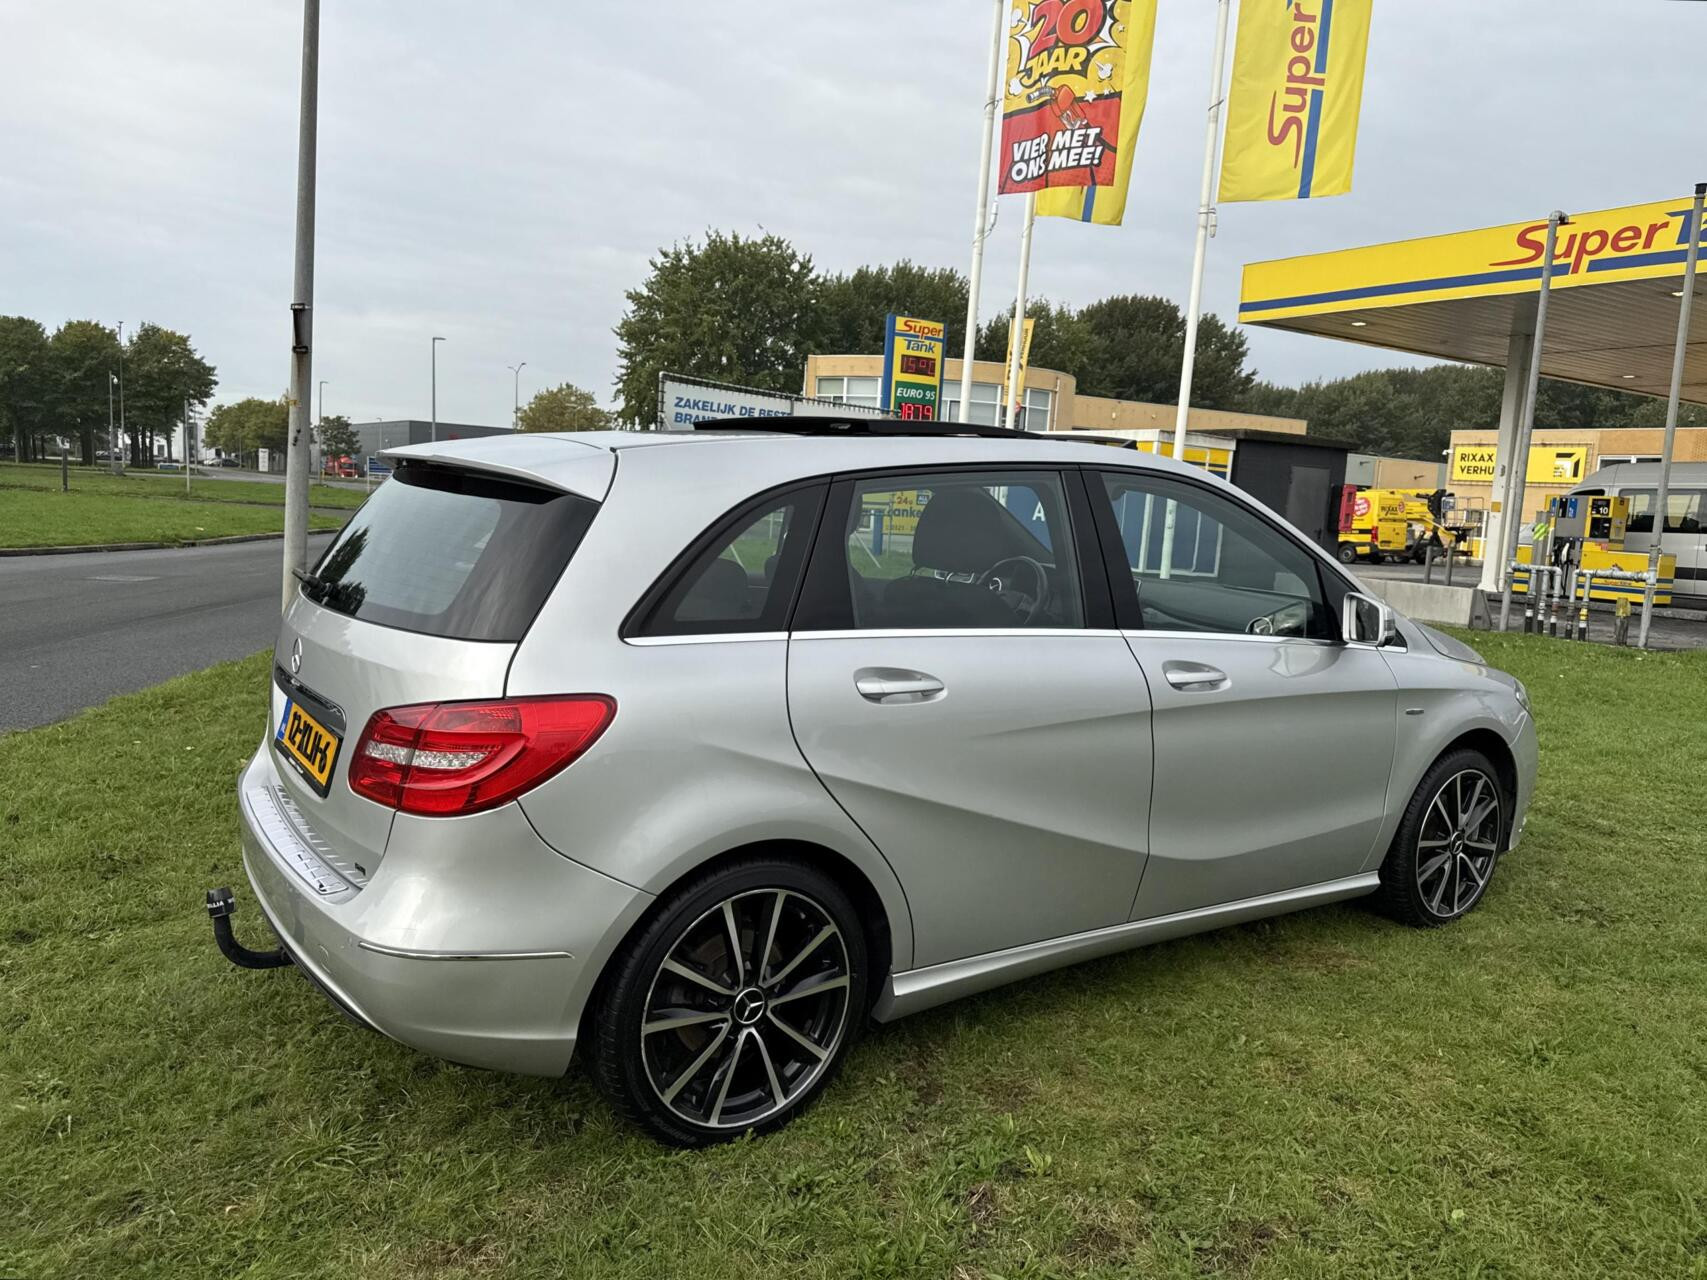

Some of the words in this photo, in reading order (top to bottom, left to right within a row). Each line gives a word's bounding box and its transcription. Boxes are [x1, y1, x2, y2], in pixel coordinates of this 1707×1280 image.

[1029, 0, 1104, 57] 20
[1021, 47, 1087, 85] JAAR
[1268, 2, 1325, 168] Super
[1013, 133, 1049, 161] VIER
[1052, 127, 1101, 150] MET
[1011, 153, 1046, 182] ONS
[1048, 145, 1103, 170] MEE!
[1488, 221, 1670, 275] Super
[896, 319, 943, 341] Super
[903, 339, 936, 354] Tank
[896, 387, 924, 400] EURO
[925, 390, 936, 400] 95
[674, 396, 737, 415] ZAKELIJK
[740, 406, 757, 417] DE
[1460, 453, 1494, 463] RIXAX
[1460, 465, 1495, 476] VERHU
[1599, 507, 1609, 515] 10
